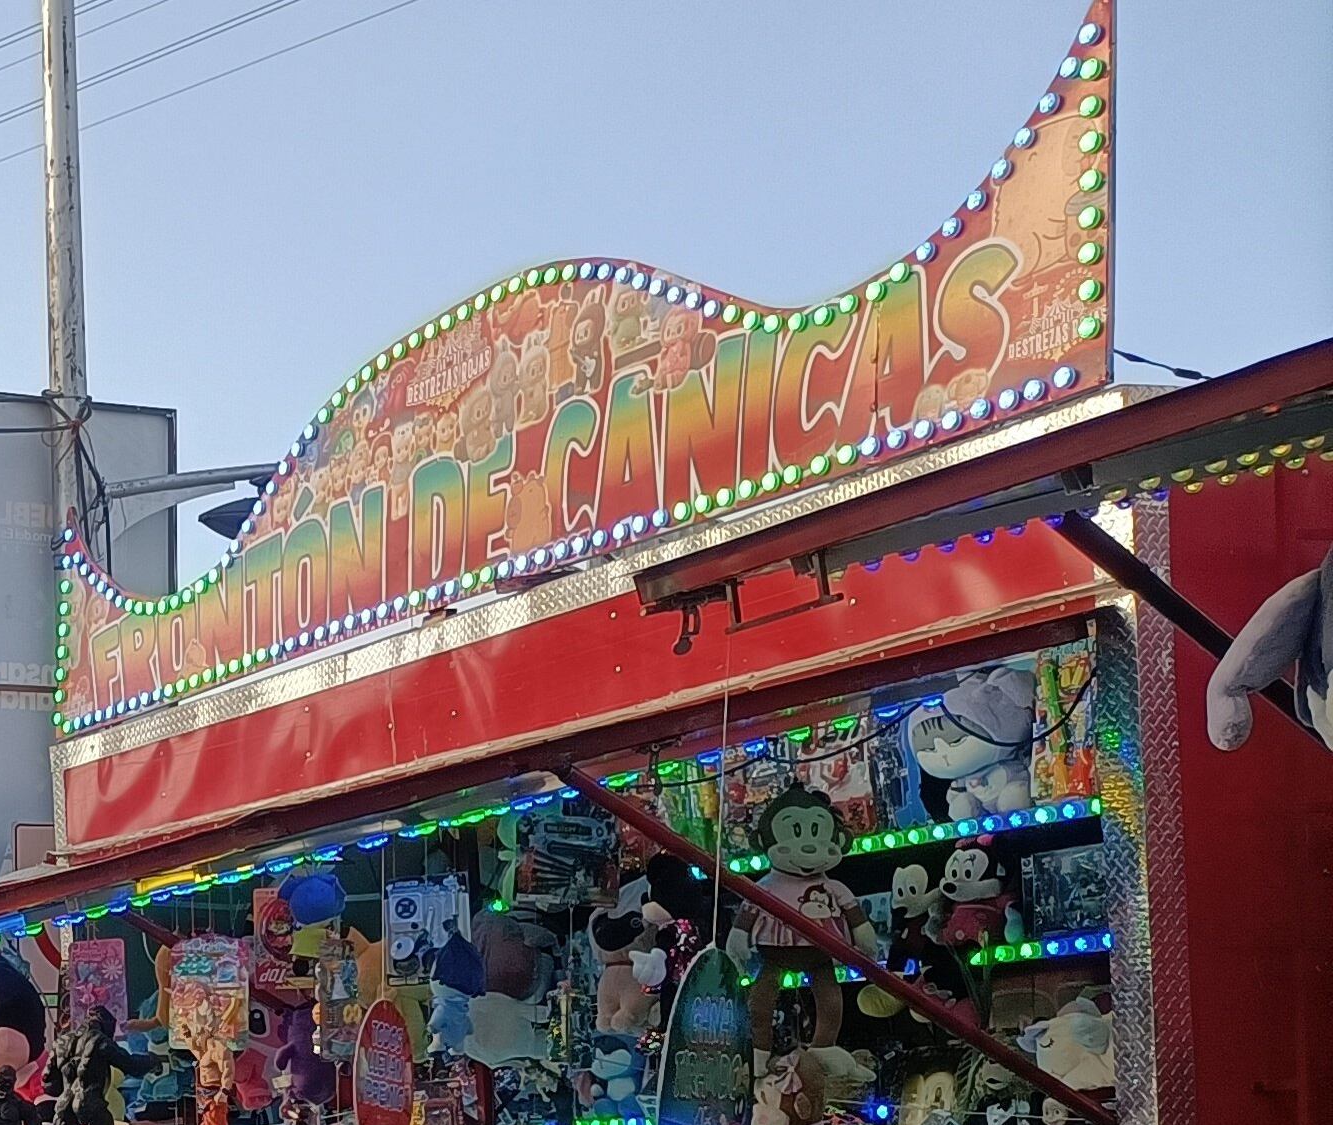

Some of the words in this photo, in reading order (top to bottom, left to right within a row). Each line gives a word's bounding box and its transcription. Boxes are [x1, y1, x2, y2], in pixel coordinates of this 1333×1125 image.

[1008, 322, 1070, 360] DESTREZAS
[407, 367, 459, 404] DESTREZAS
[461, 349, 491, 386] ROJAS
[90, 486, 389, 710] FRONTÓN
[410, 431, 516, 595] DE
[543, 238, 1023, 532] CANICAS
